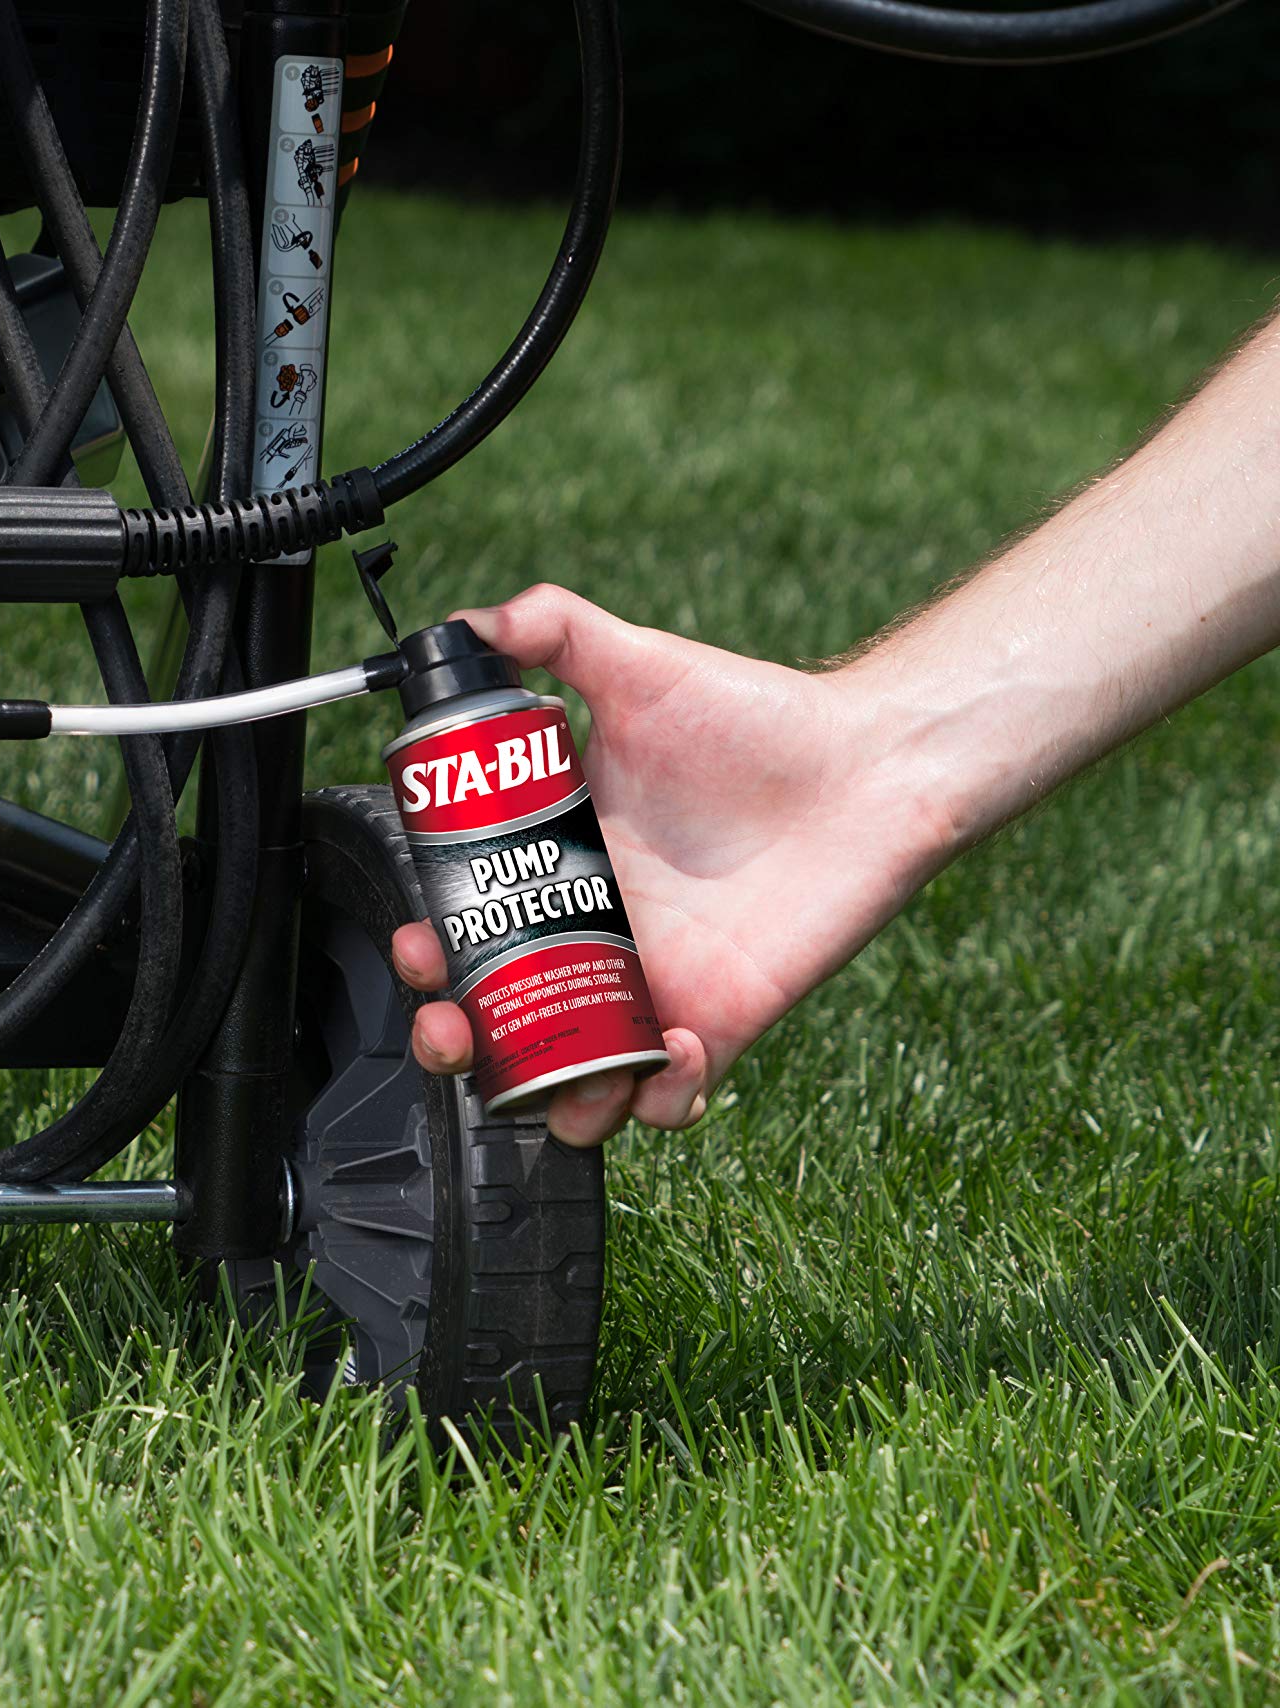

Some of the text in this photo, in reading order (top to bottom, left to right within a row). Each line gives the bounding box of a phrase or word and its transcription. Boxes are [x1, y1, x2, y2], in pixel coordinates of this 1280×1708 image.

[402, 725, 571, 813] STA-BIL
[470, 840, 560, 893] PUMP
[443, 876, 613, 952] PROTECTOR
[478, 959, 625, 1009] PROTECTS PRESSURE WASHER PUMP AND OTHER
[492, 973, 621, 1019] INTERNAL COMPONENTS DURING STORAGE
[491, 991, 634, 1042] NEXT GEN ANTI-FREEZE & LUBRICANT FORMULA
